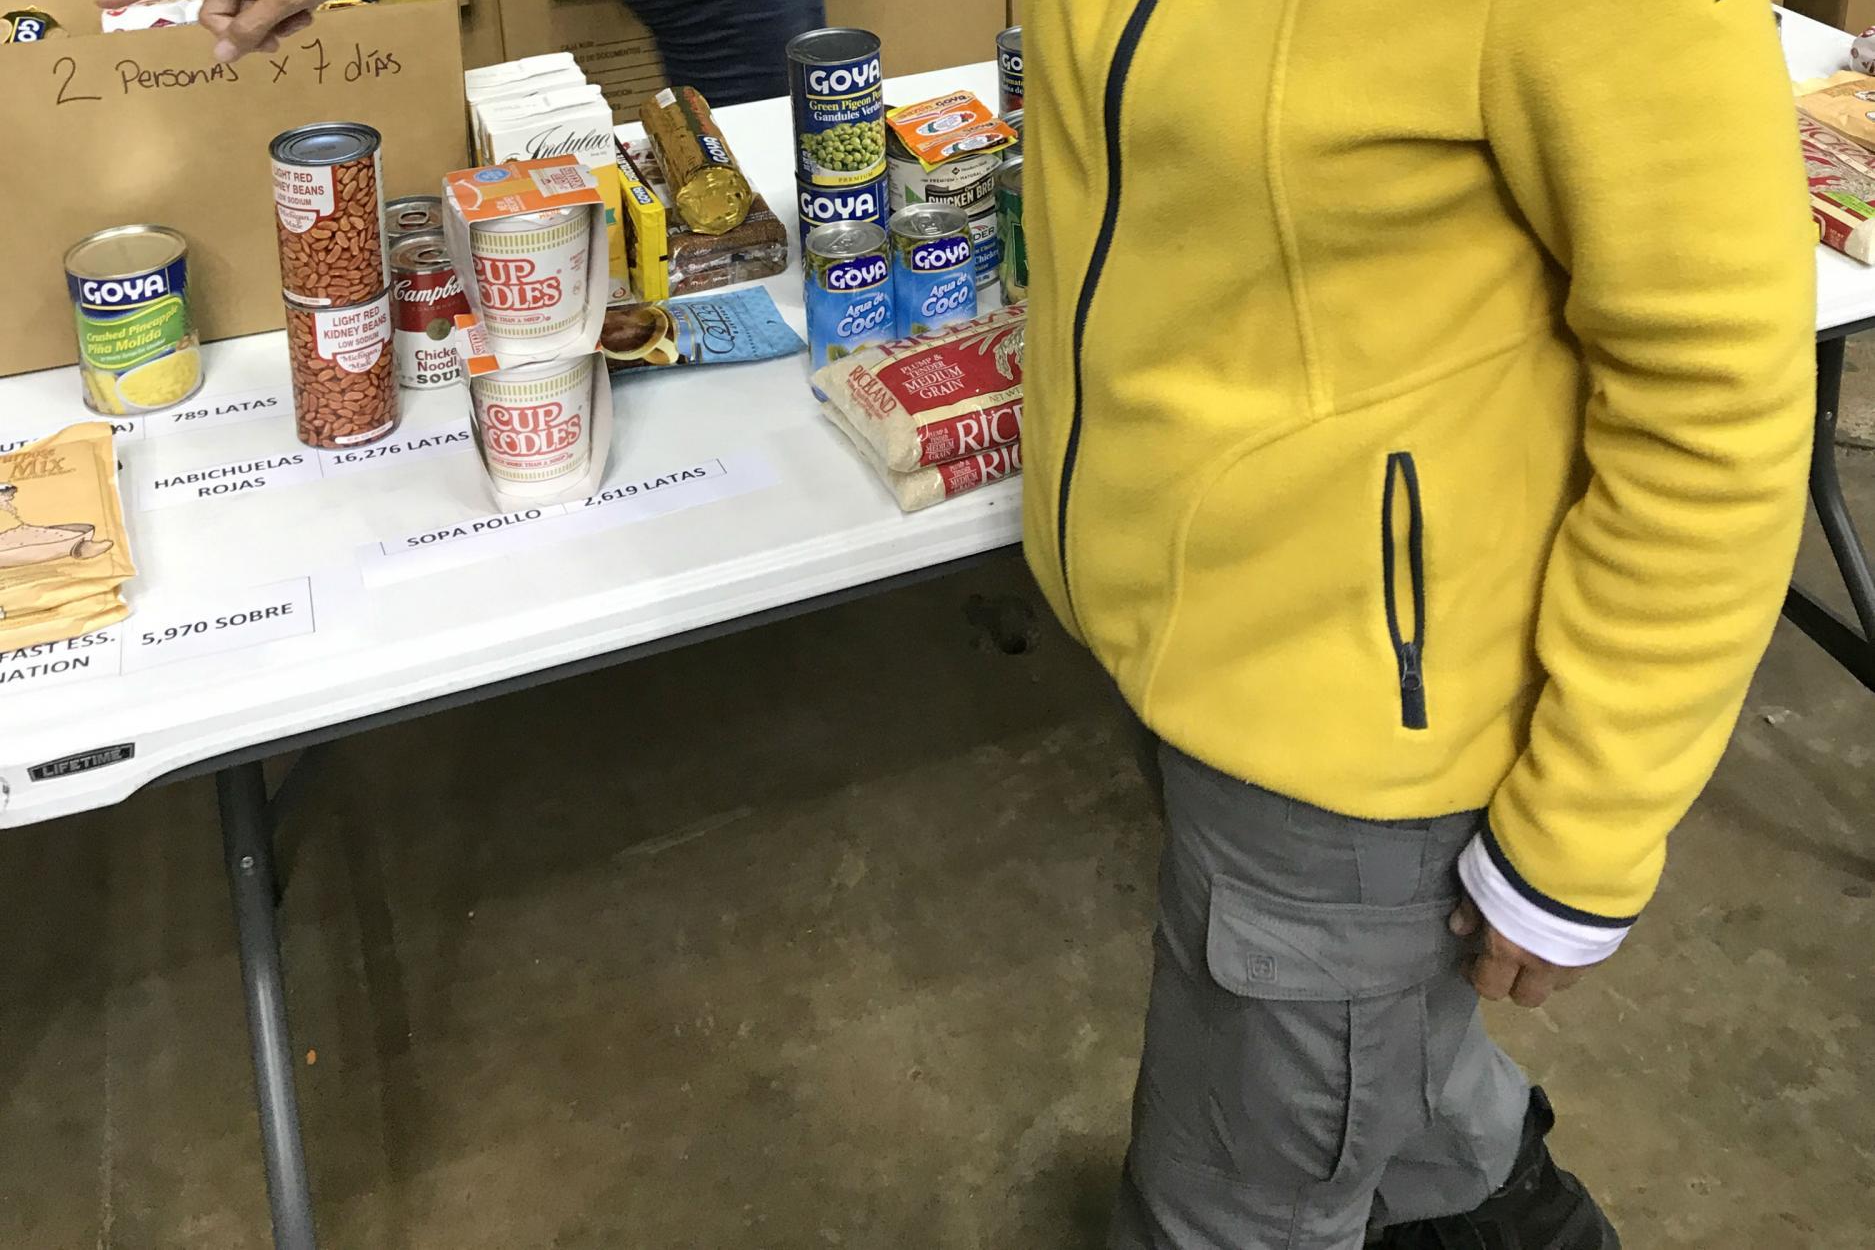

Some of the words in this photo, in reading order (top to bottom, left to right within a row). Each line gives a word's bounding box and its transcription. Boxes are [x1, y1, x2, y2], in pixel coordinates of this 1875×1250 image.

[53, 57, 103, 105] 2
[301, 38, 330, 85] 7
[1002, 53, 1023, 71] GO
[809, 59, 880, 95] GOYA
[809, 99, 839, 112] Green
[841, 95, 872, 112] Pigeon
[814, 109, 860, 122] Gandules
[293, 172, 313, 183] RED
[293, 185, 325, 195] BEANS
[800, 192, 875, 219] GOYA
[914, 242, 970, 269] GOYA
[829, 260, 886, 289] GOYA
[83, 274, 165, 304] GOYA
[929, 281, 955, 298] Agua
[332, 313, 361, 327] LIGHT
[363, 306, 380, 319] RED
[846, 301, 872, 317] Agua
[116, 328, 161, 352] Molida
[323, 326, 360, 340] KIDNEY
[362, 313, 387, 333] BEANS
[338, 340, 354, 349] LOW
[355, 331, 380, 346] SODIUM
[415, 347, 458, 361] Chicke
[417, 357, 458, 372] Noodl
[900, 356, 932, 374] PLUMP
[903, 365, 964, 393] MEDIUM
[909, 359, 947, 378] TENDER
[849, 365, 897, 414] RICELAND
[919, 378, 965, 399] GRAIN
[172, 409, 209, 423] 789
[215, 396, 279, 416] LATAS
[487, 402, 563, 433] CUP
[333, 445, 402, 466] 16,276
[407, 430, 470, 451] LATAS
[487, 414, 581, 456] OODLES
[154, 454, 305, 490] HABICHUELAS
[198, 477, 266, 498] ROJAS
[583, 485, 639, 508] 2,619
[643, 467, 707, 490] LATAS
[407, 527, 467, 548] SOPA
[472, 508, 542, 534] POLLO
[141, 621, 208, 646] 5,970
[215, 602, 294, 630] SOBRE
[0, 641, 60, 664] FAST
[67, 632, 116, 650] ESS.
[0, 655, 90, 684] ATION
[42, 749, 122, 778] LIFETIME
